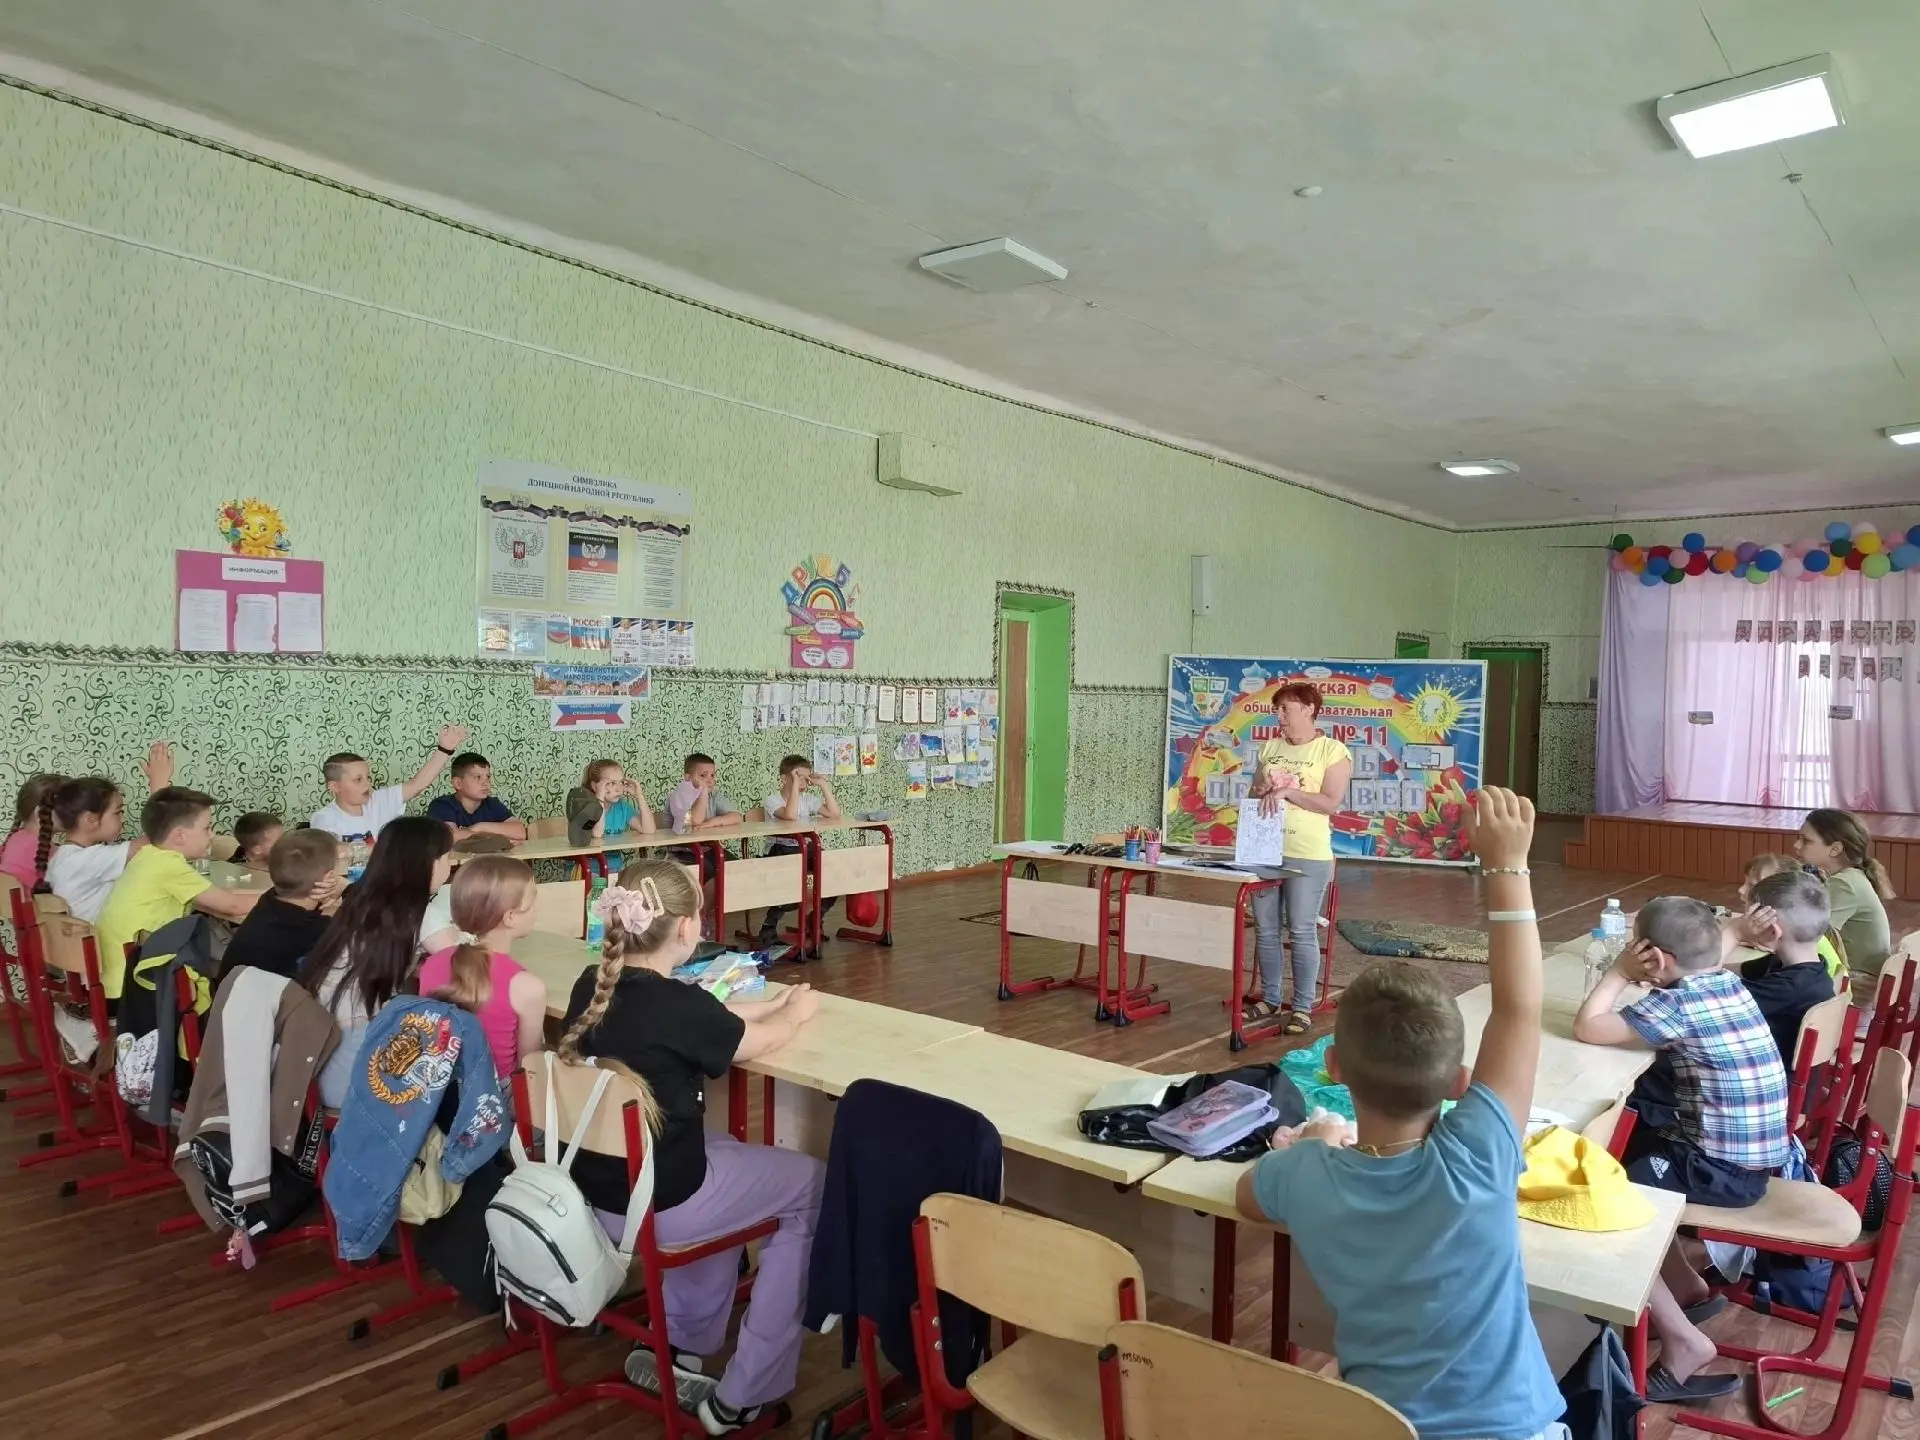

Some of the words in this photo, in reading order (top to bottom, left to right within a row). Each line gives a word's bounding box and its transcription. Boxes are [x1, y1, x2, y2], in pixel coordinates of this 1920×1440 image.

[571, 484, 610, 498] НАРОДНОЙ
[228, 566, 279, 575] ИНФОРМАЦИЯ
[1244, 702, 1393, 717] общеовательная
[1332, 725, 1356, 744] №
[1363, 726, 1387, 746] 11
